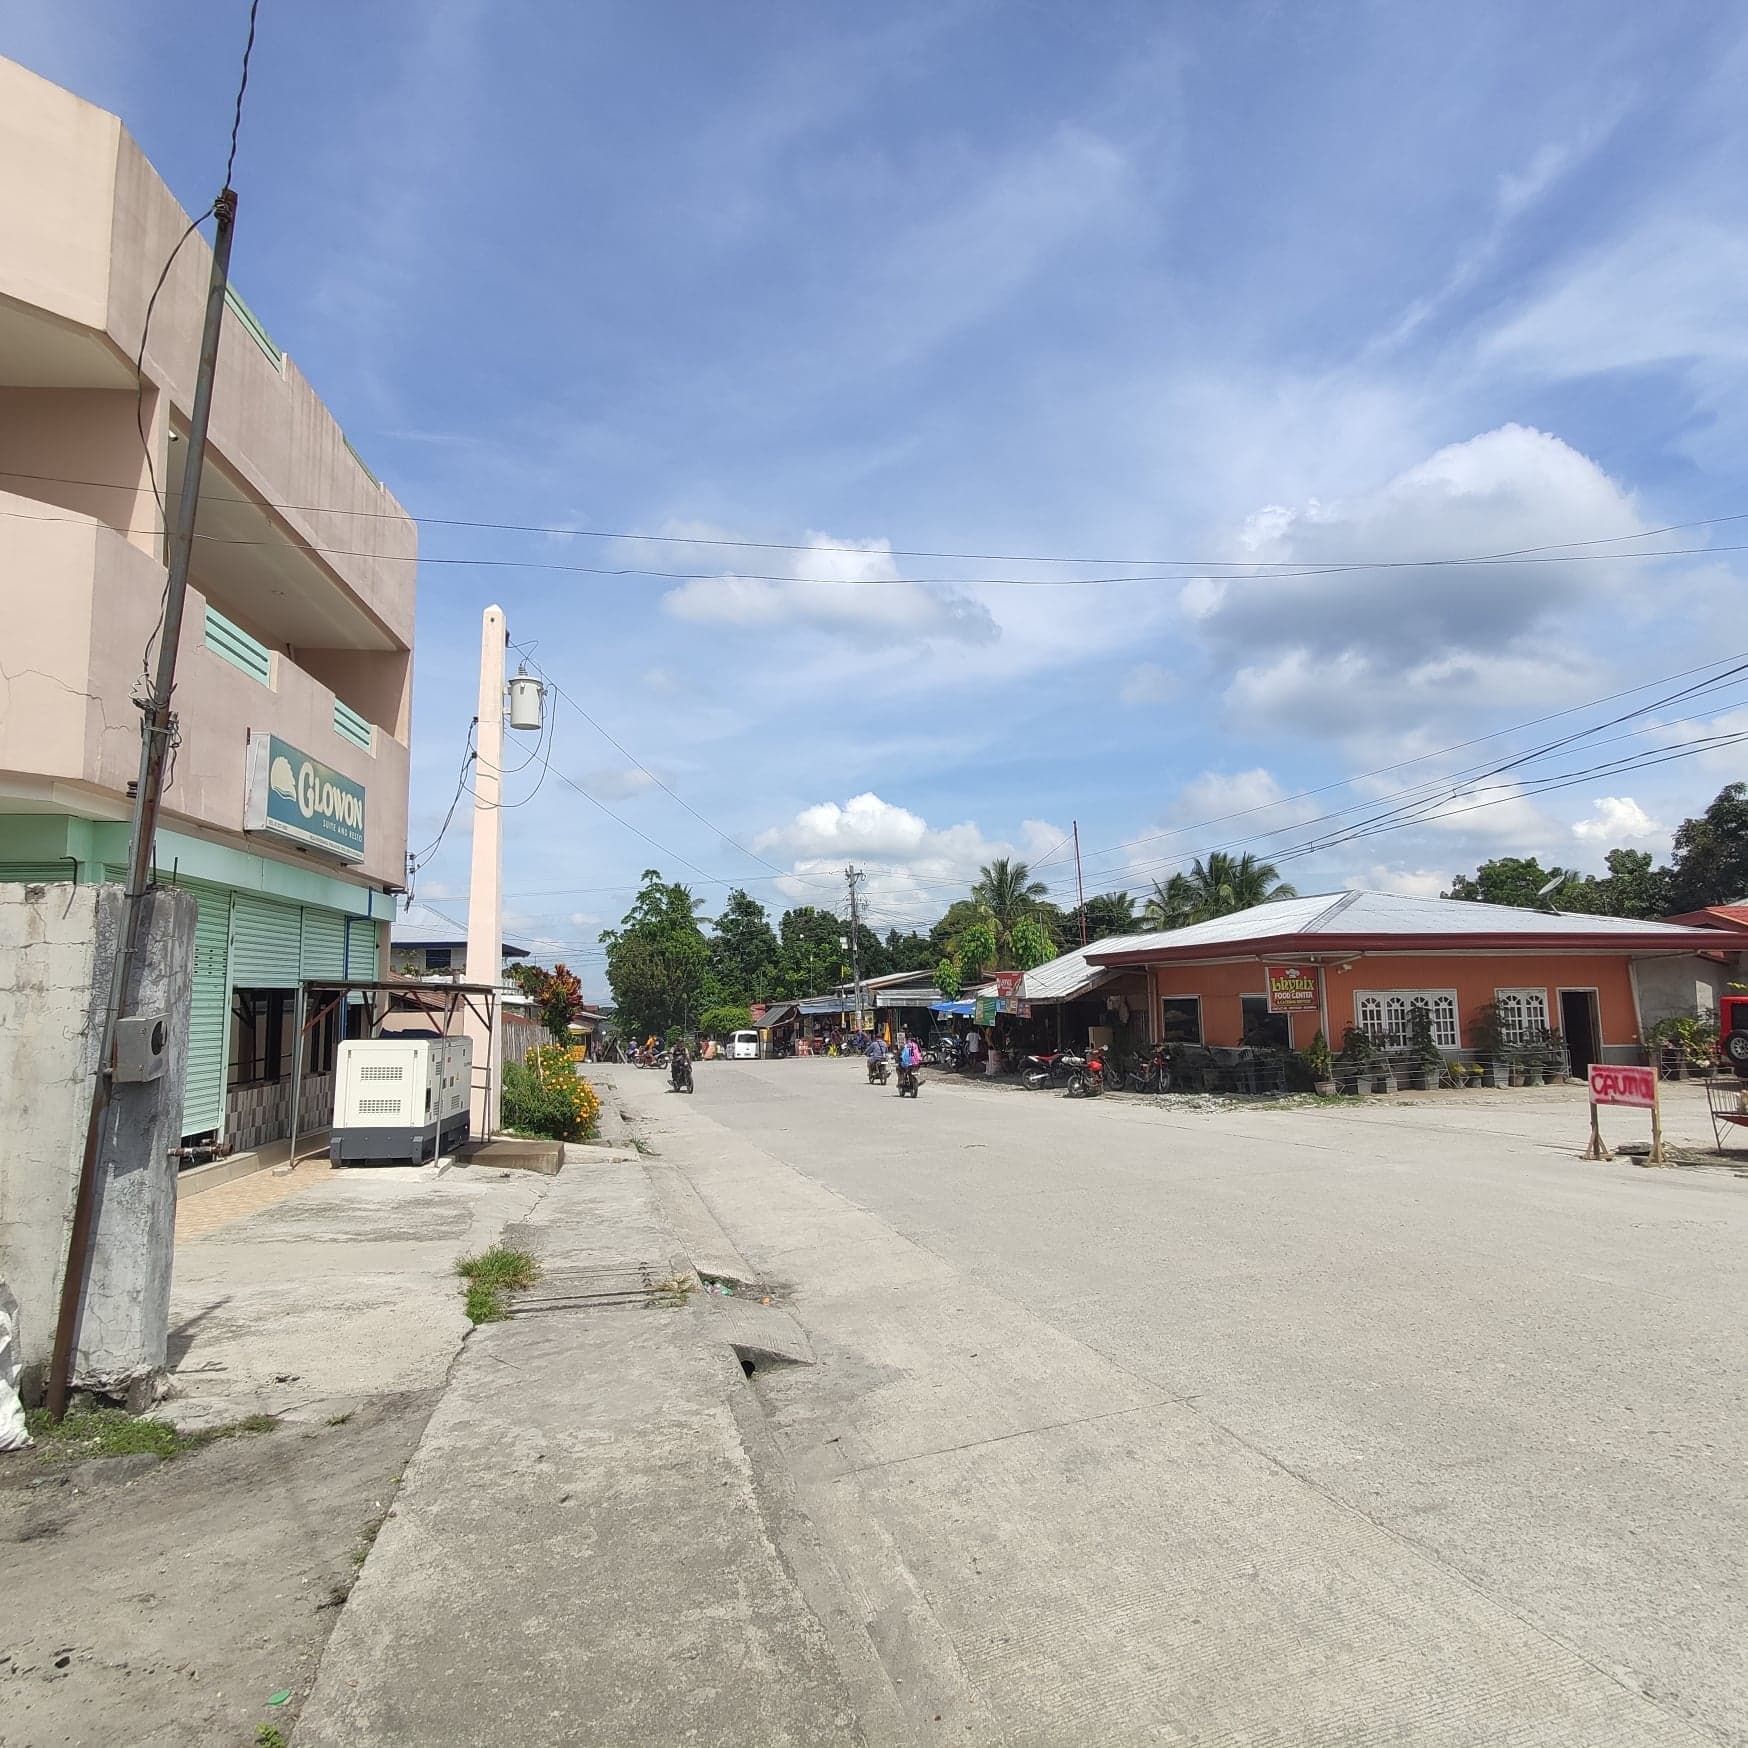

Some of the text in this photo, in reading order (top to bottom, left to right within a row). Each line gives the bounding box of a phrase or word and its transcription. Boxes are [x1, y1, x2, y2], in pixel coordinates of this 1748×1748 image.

[323, 819, 363, 842] SUITE AND RESTO
[1291, 991, 1313, 999] CENTER
